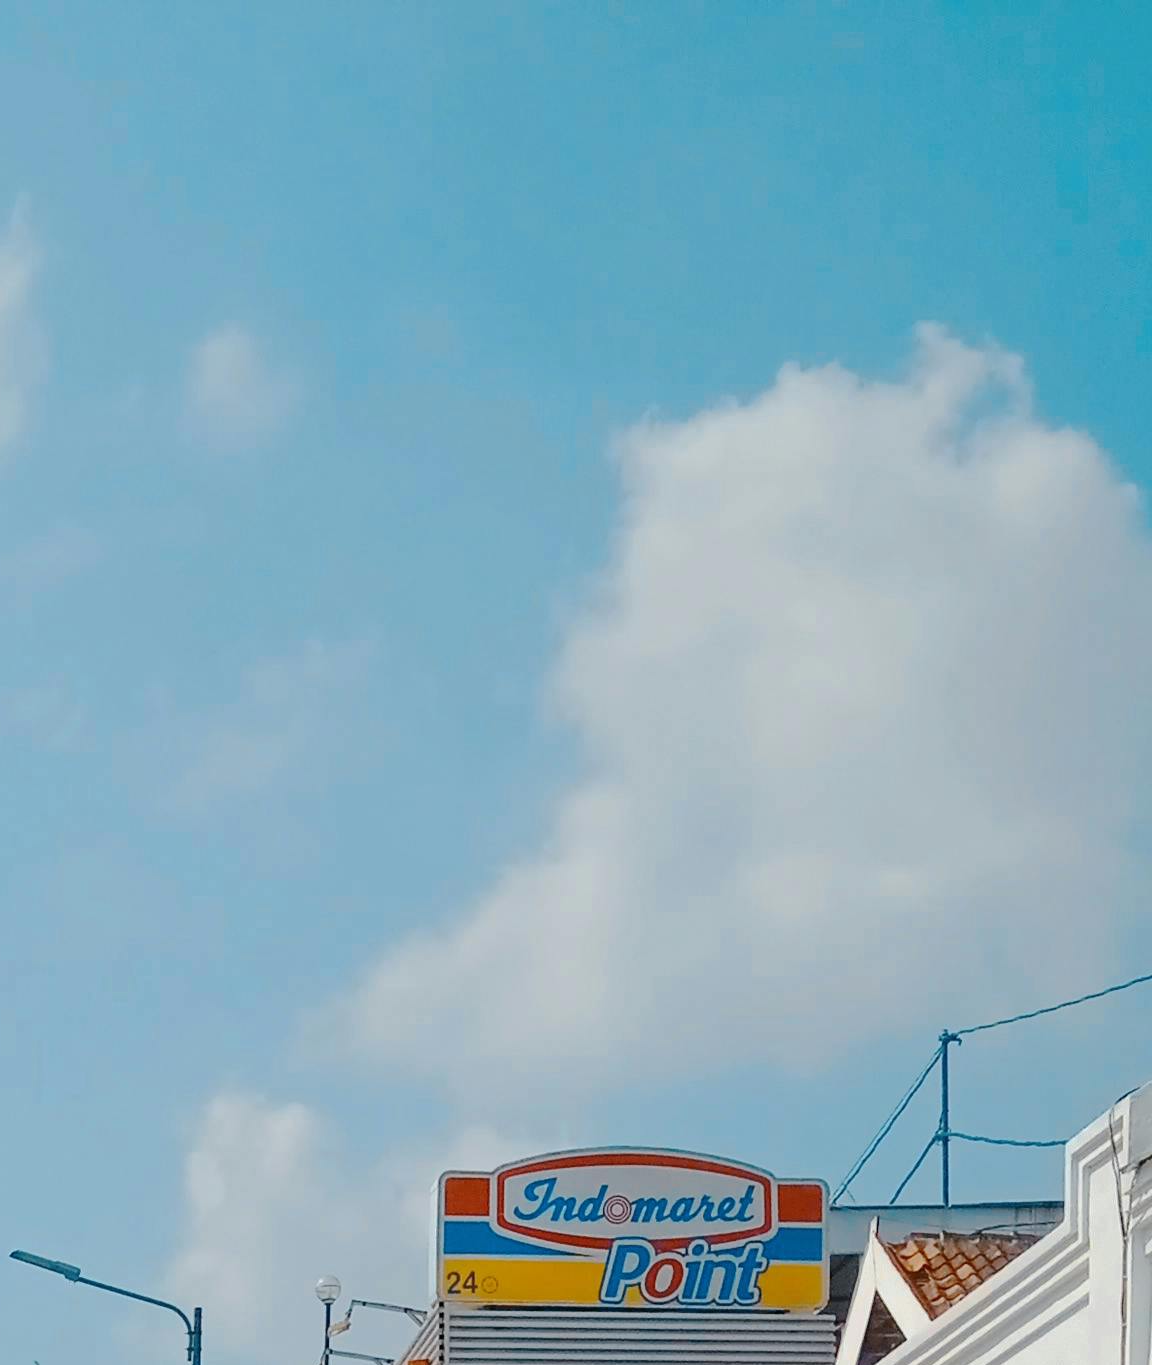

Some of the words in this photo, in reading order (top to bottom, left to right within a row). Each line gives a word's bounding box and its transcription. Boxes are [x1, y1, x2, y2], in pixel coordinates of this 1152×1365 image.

[514, 1177, 755, 1225] Indomaret
[447, 1270, 478, 1295] 24
[603, 1239, 765, 1304] Point
